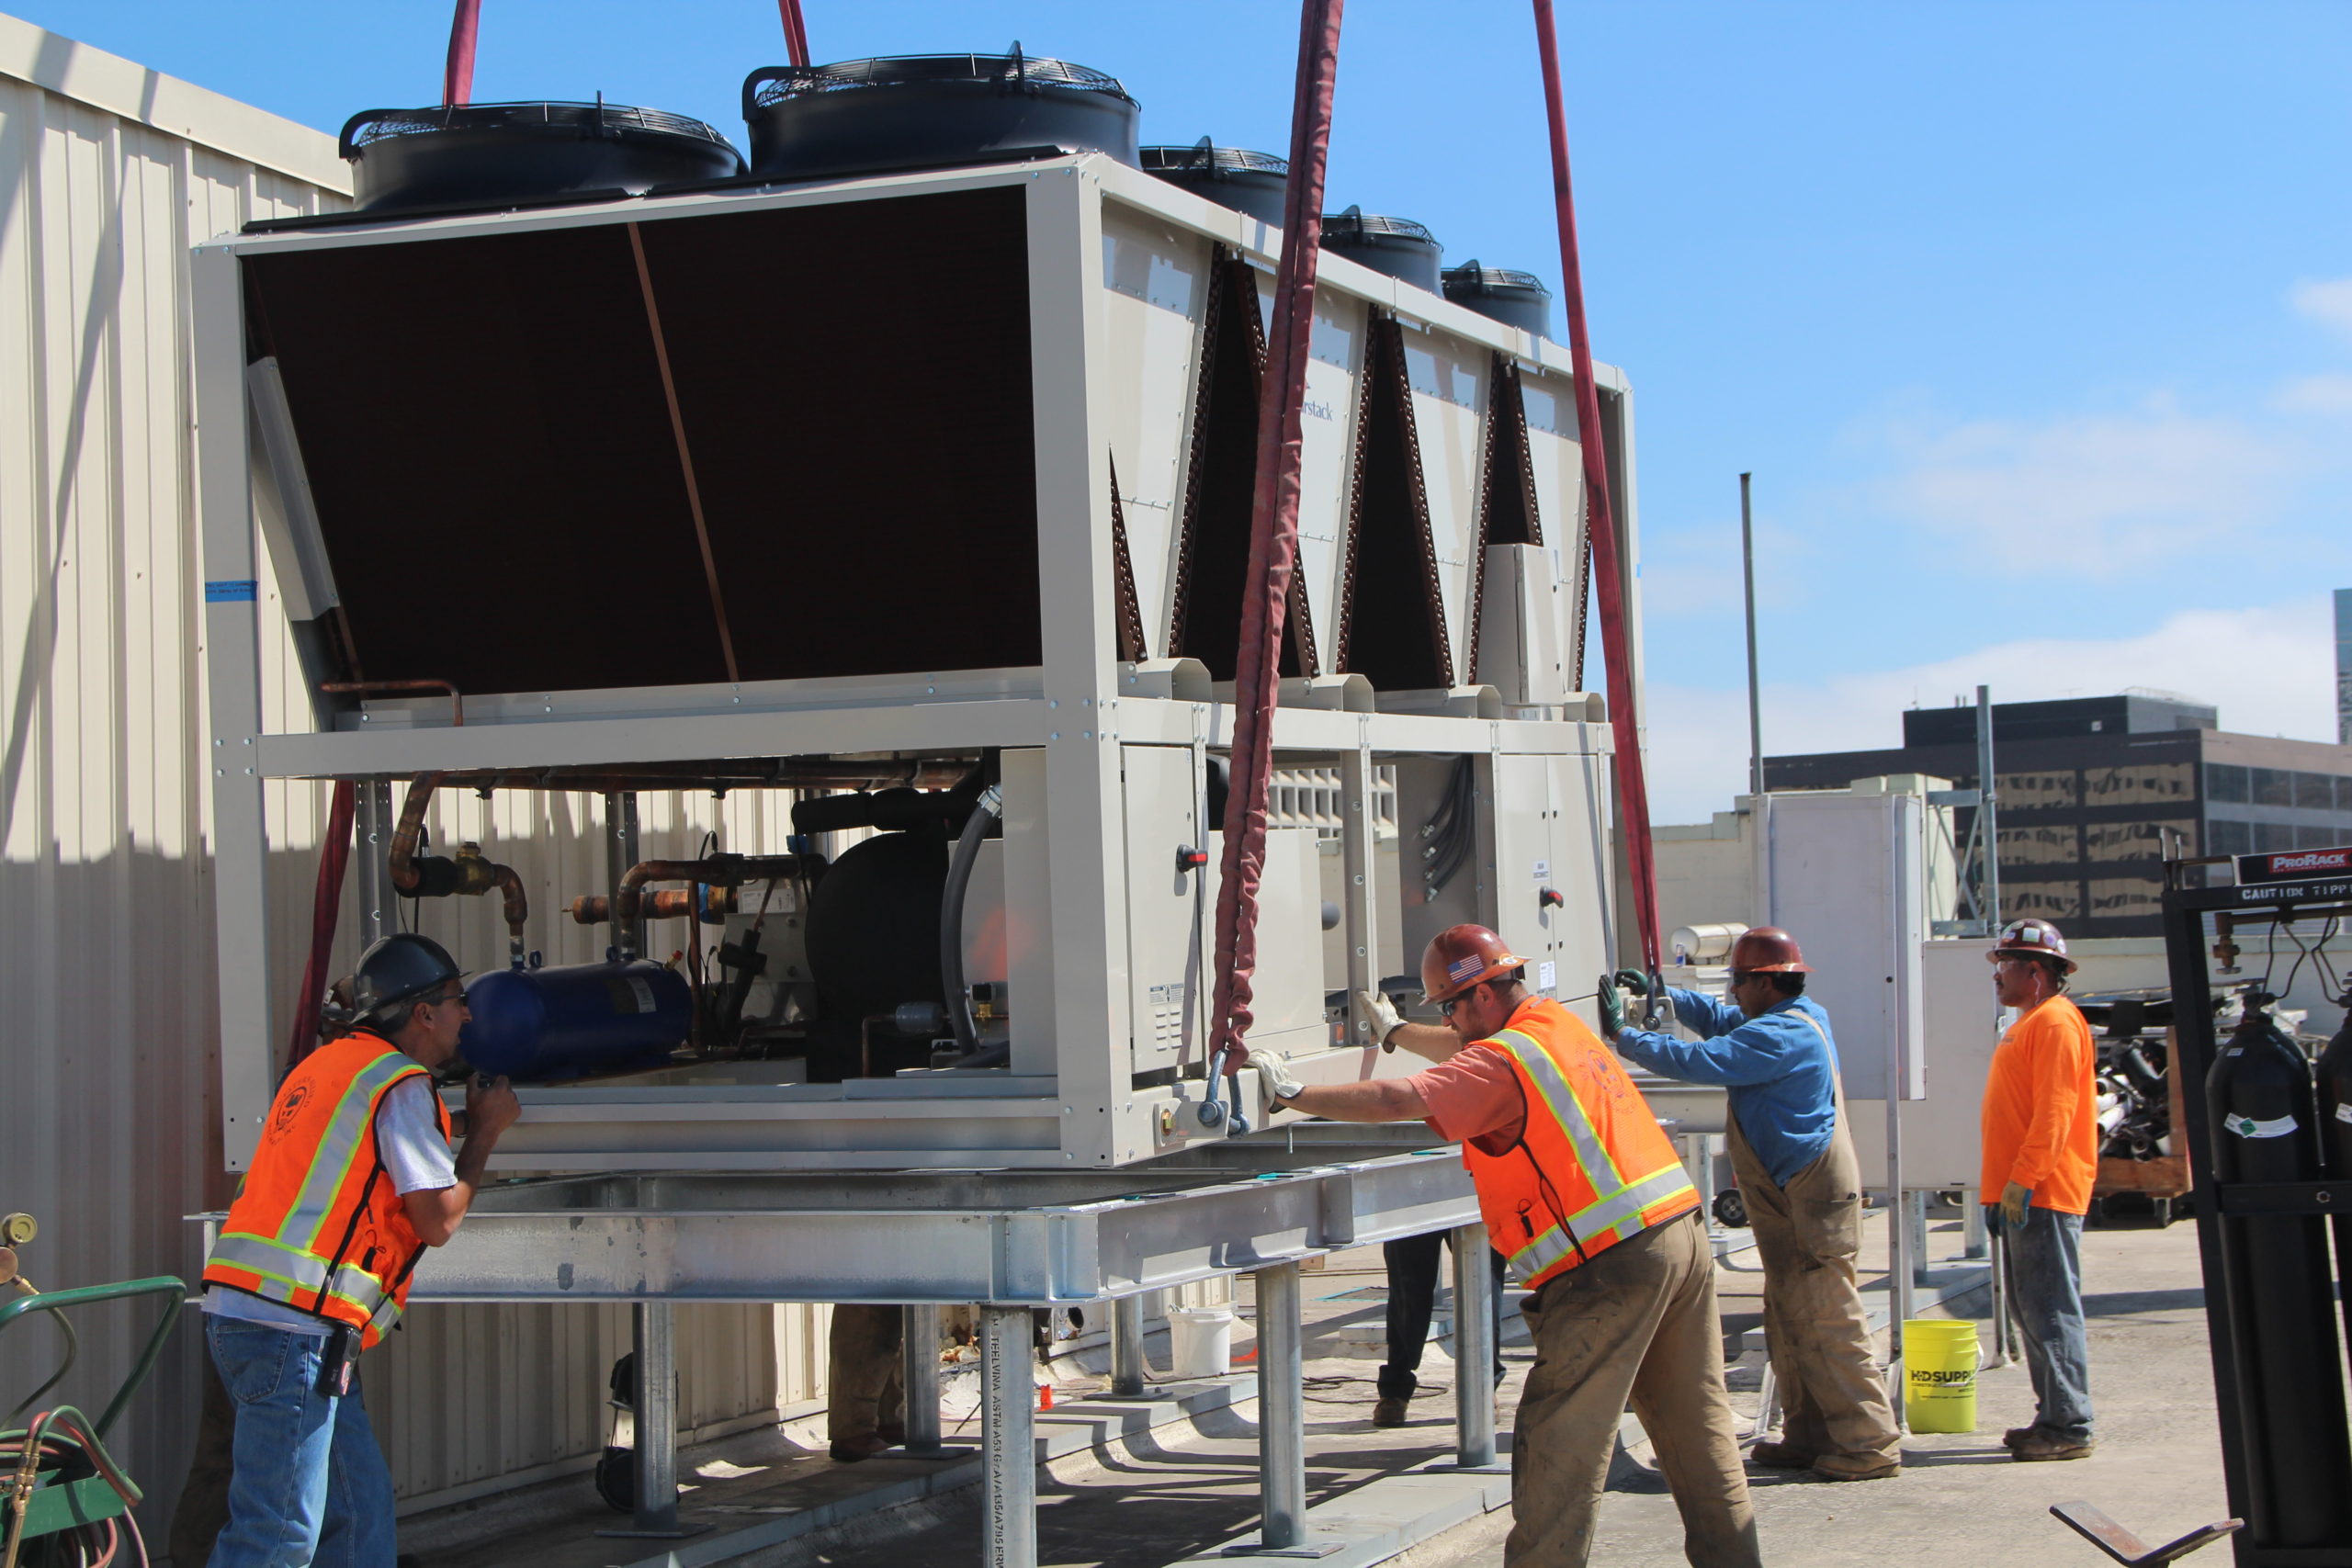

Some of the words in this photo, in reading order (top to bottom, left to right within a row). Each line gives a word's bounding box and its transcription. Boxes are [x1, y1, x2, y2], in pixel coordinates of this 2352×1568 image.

[2242, 886, 2304, 900] CAUTION
[991, 1332, 1001, 1391] TEELVINA
[992, 1395, 1001, 1427] ASTM
